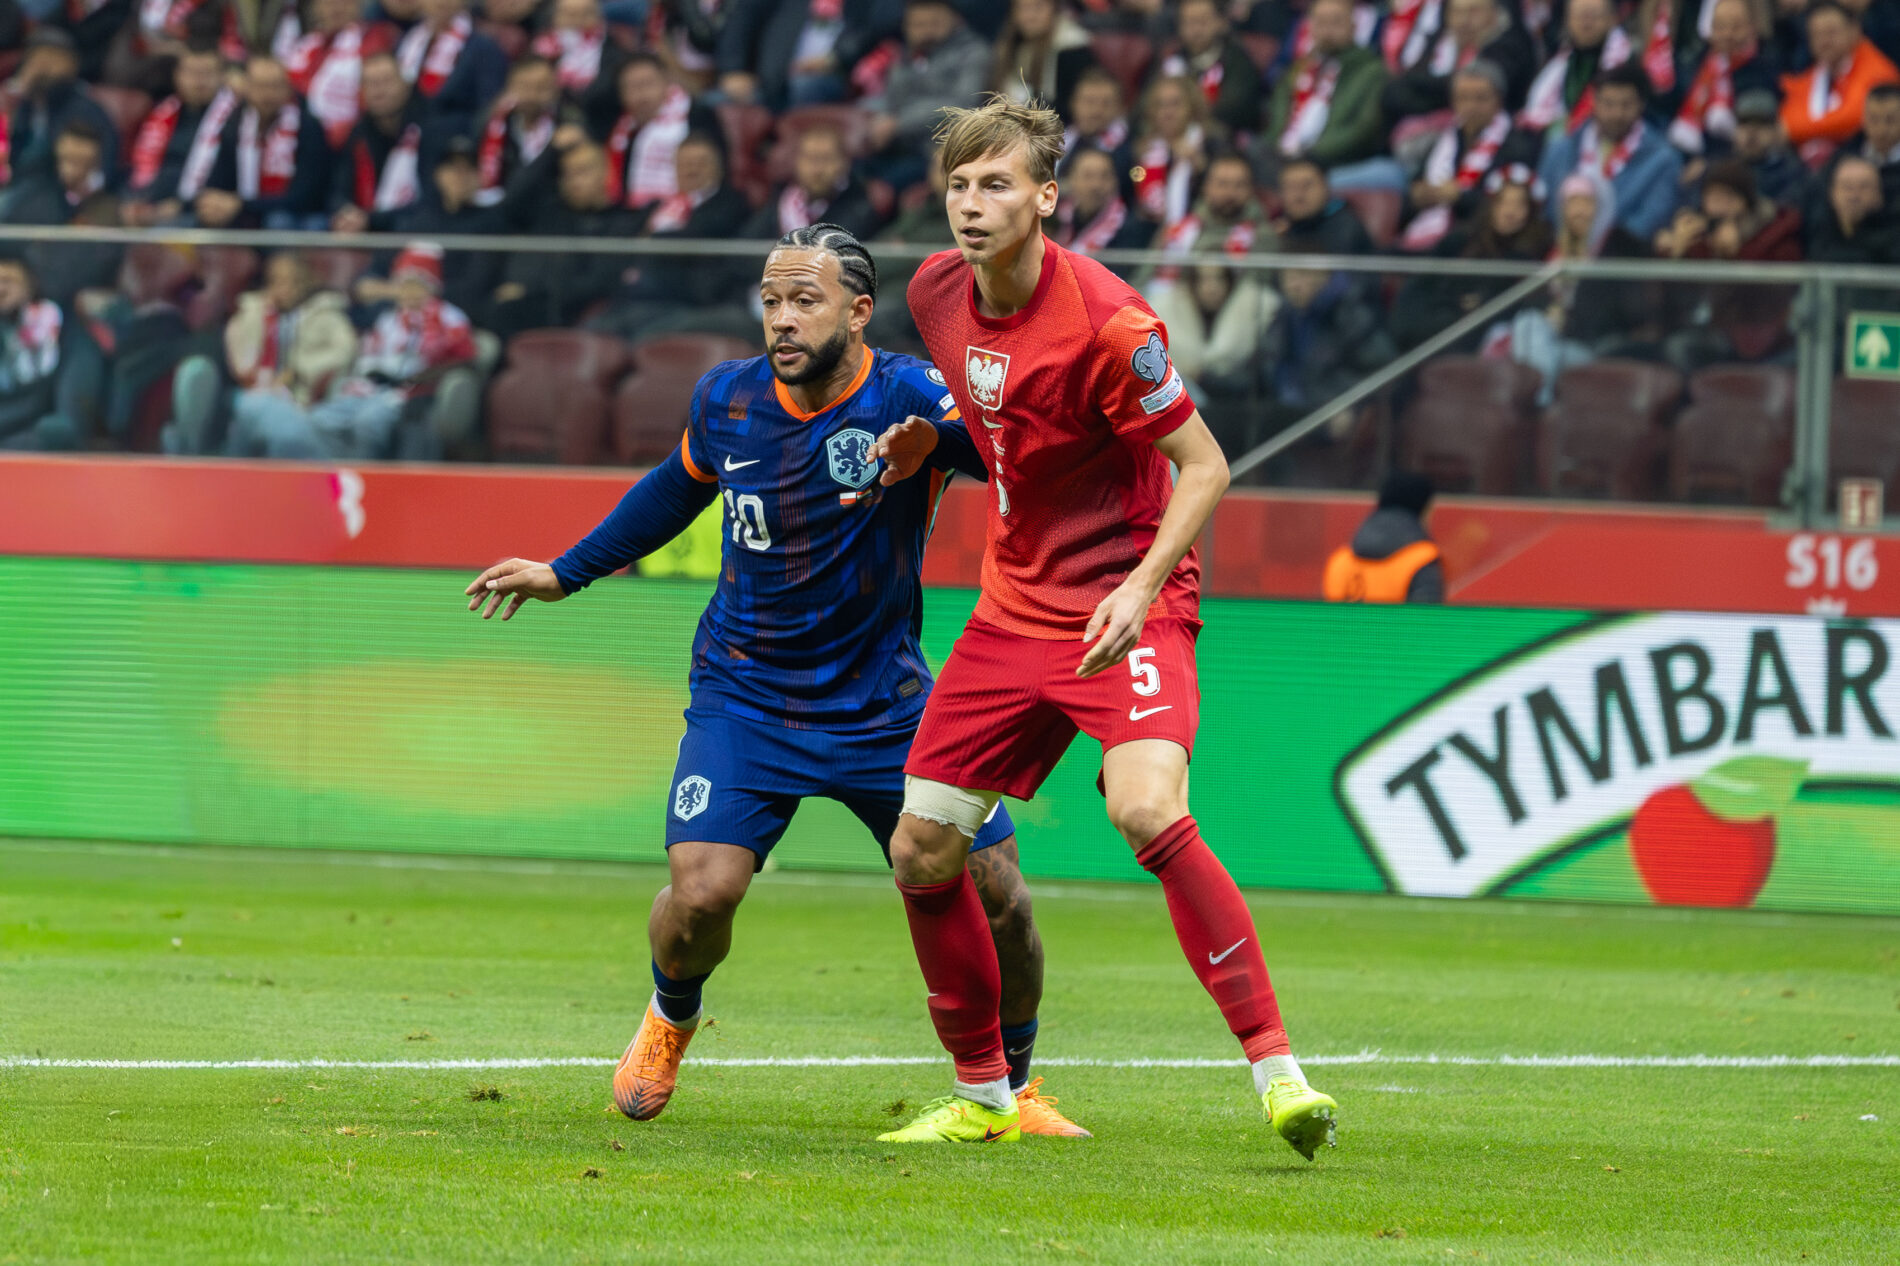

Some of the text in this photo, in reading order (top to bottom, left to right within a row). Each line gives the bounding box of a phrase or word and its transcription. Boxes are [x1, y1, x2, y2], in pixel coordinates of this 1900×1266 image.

[724, 488, 771, 550] 10
[1785, 533, 1879, 591] S16
[1128, 647, 1161, 697] 5
[1384, 628, 1895, 864] TYMBAR
